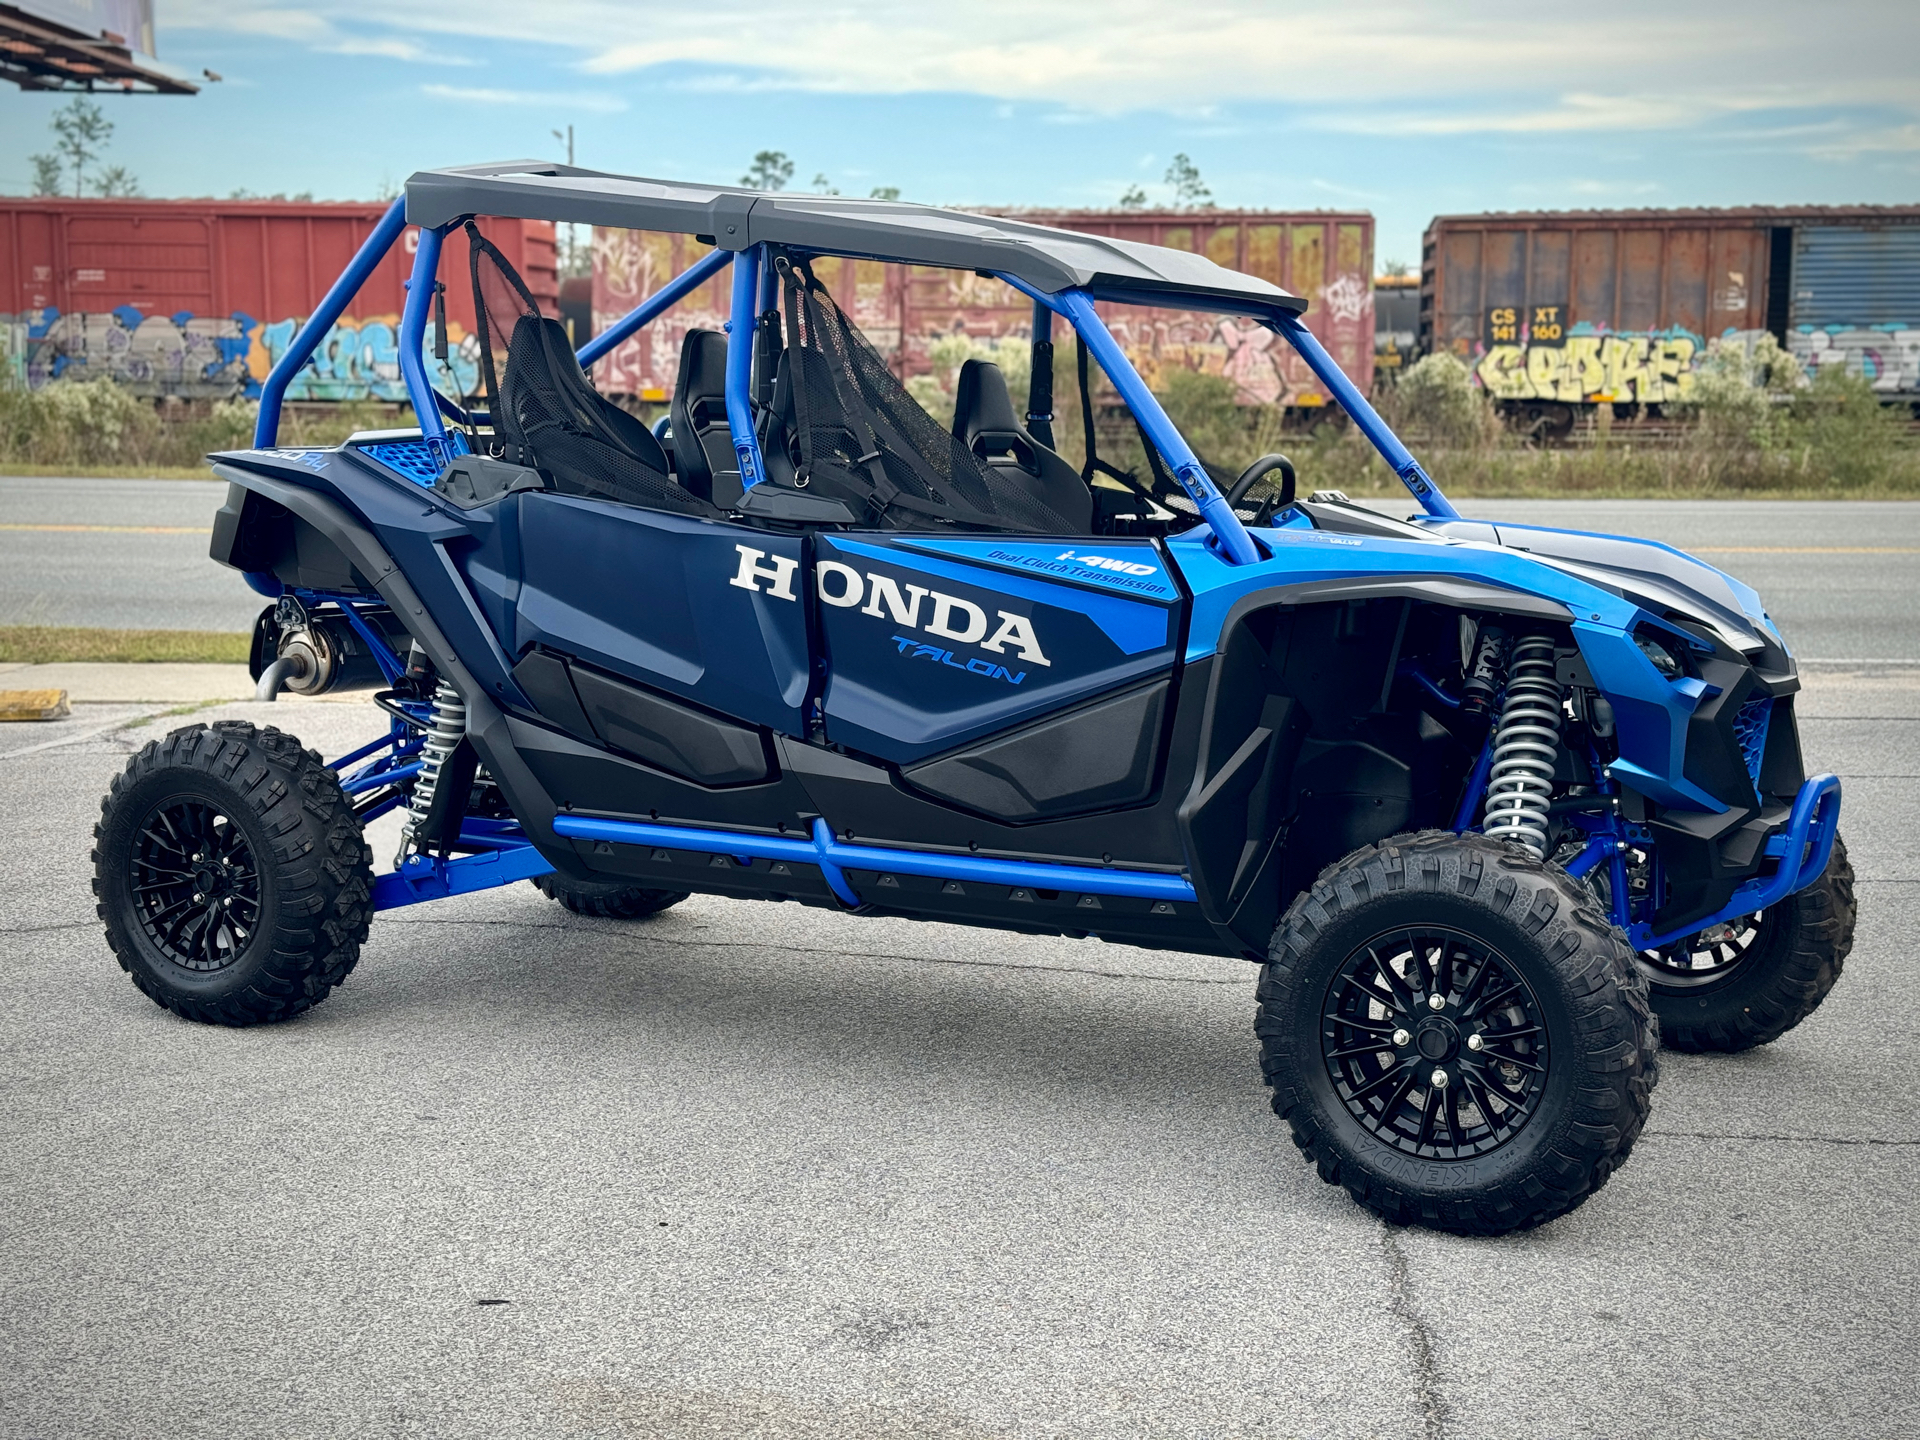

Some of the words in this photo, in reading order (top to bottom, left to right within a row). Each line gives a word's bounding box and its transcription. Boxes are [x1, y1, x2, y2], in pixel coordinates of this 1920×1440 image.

[1490, 308, 1517, 325] CS
[1534, 307, 1559, 323] XT
[1491, 325, 1517, 341] 141
[1531, 324, 1562, 340] 160
[987, 550, 1020, 563] Dual
[1022, 557, 1069, 574] Clutch
[1071, 566, 1167, 594] Transmission
[1055, 550, 1158, 576] i-4WD
[729, 543, 1051, 667] HONDA
[891, 635, 1027, 685] TALON
[1474, 634, 1503, 681] FOX
[1352, 1132, 1477, 1187] KENDA
